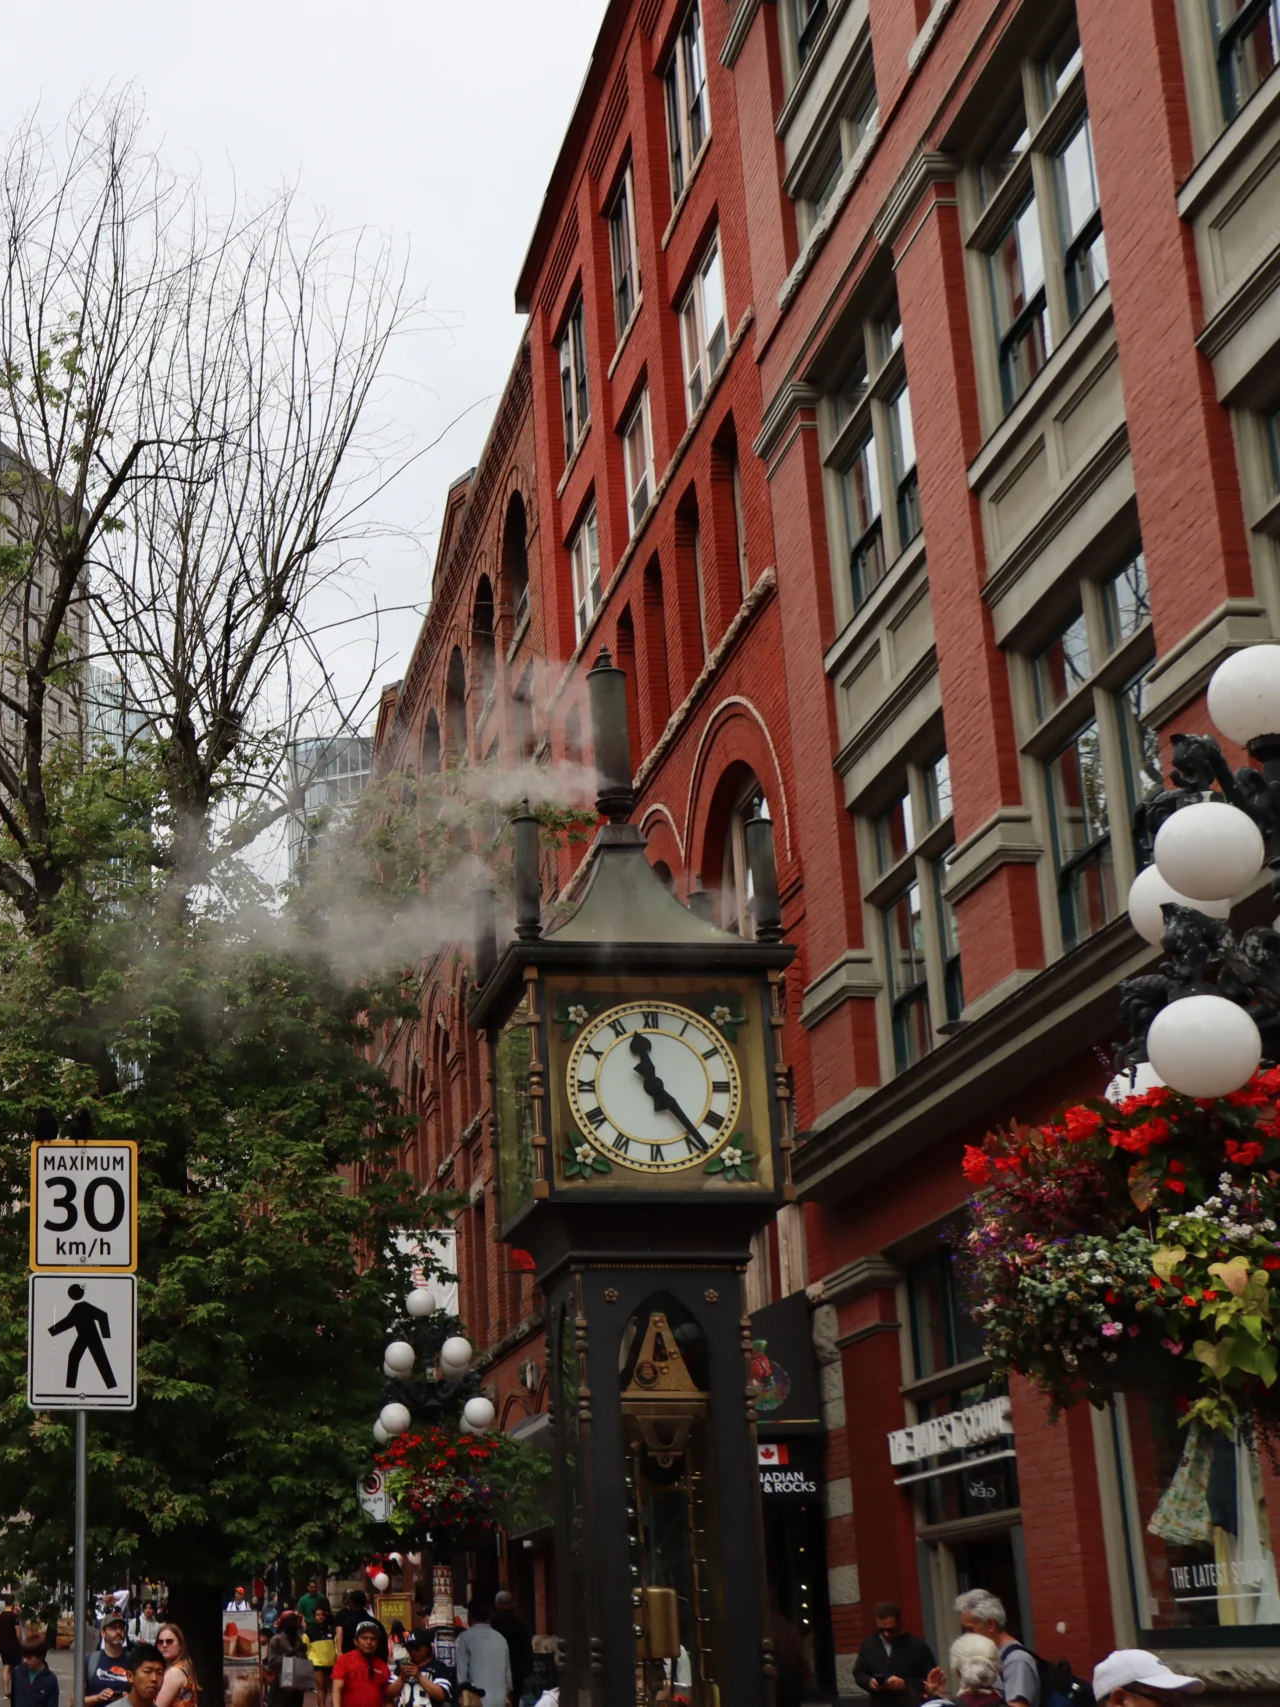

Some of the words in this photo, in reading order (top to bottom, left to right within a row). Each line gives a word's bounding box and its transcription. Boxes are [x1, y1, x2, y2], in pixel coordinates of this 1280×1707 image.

[43, 1155, 125, 1171] MAXIMUM
[43, 1176, 125, 1232] 30
[56, 1237, 111, 1258] km/h
[774, 1481, 817, 1493] ROCKS
[1170, 1566, 1192, 1590] THE
[1191, 1562, 1229, 1588] LATEST
[381, 1604, 404, 1613] SALE
